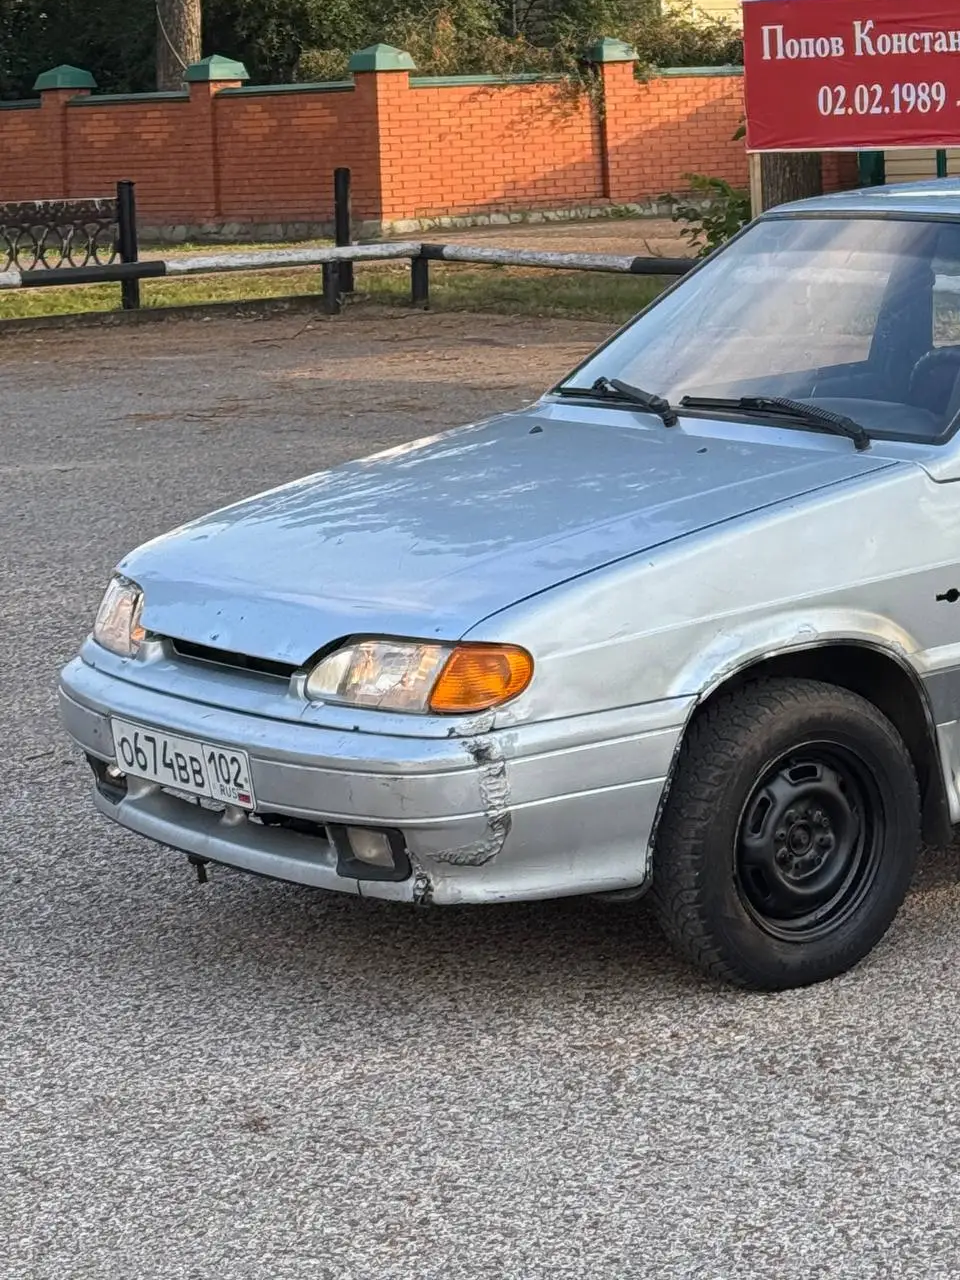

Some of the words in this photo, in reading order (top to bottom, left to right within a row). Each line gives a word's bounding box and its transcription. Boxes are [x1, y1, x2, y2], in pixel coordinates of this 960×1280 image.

[761, 24, 845, 60] Попов
[817, 81, 947, 116] 02.02.1989
[207, 751, 245, 789] 102
[219, 784, 238, 800] RUS
